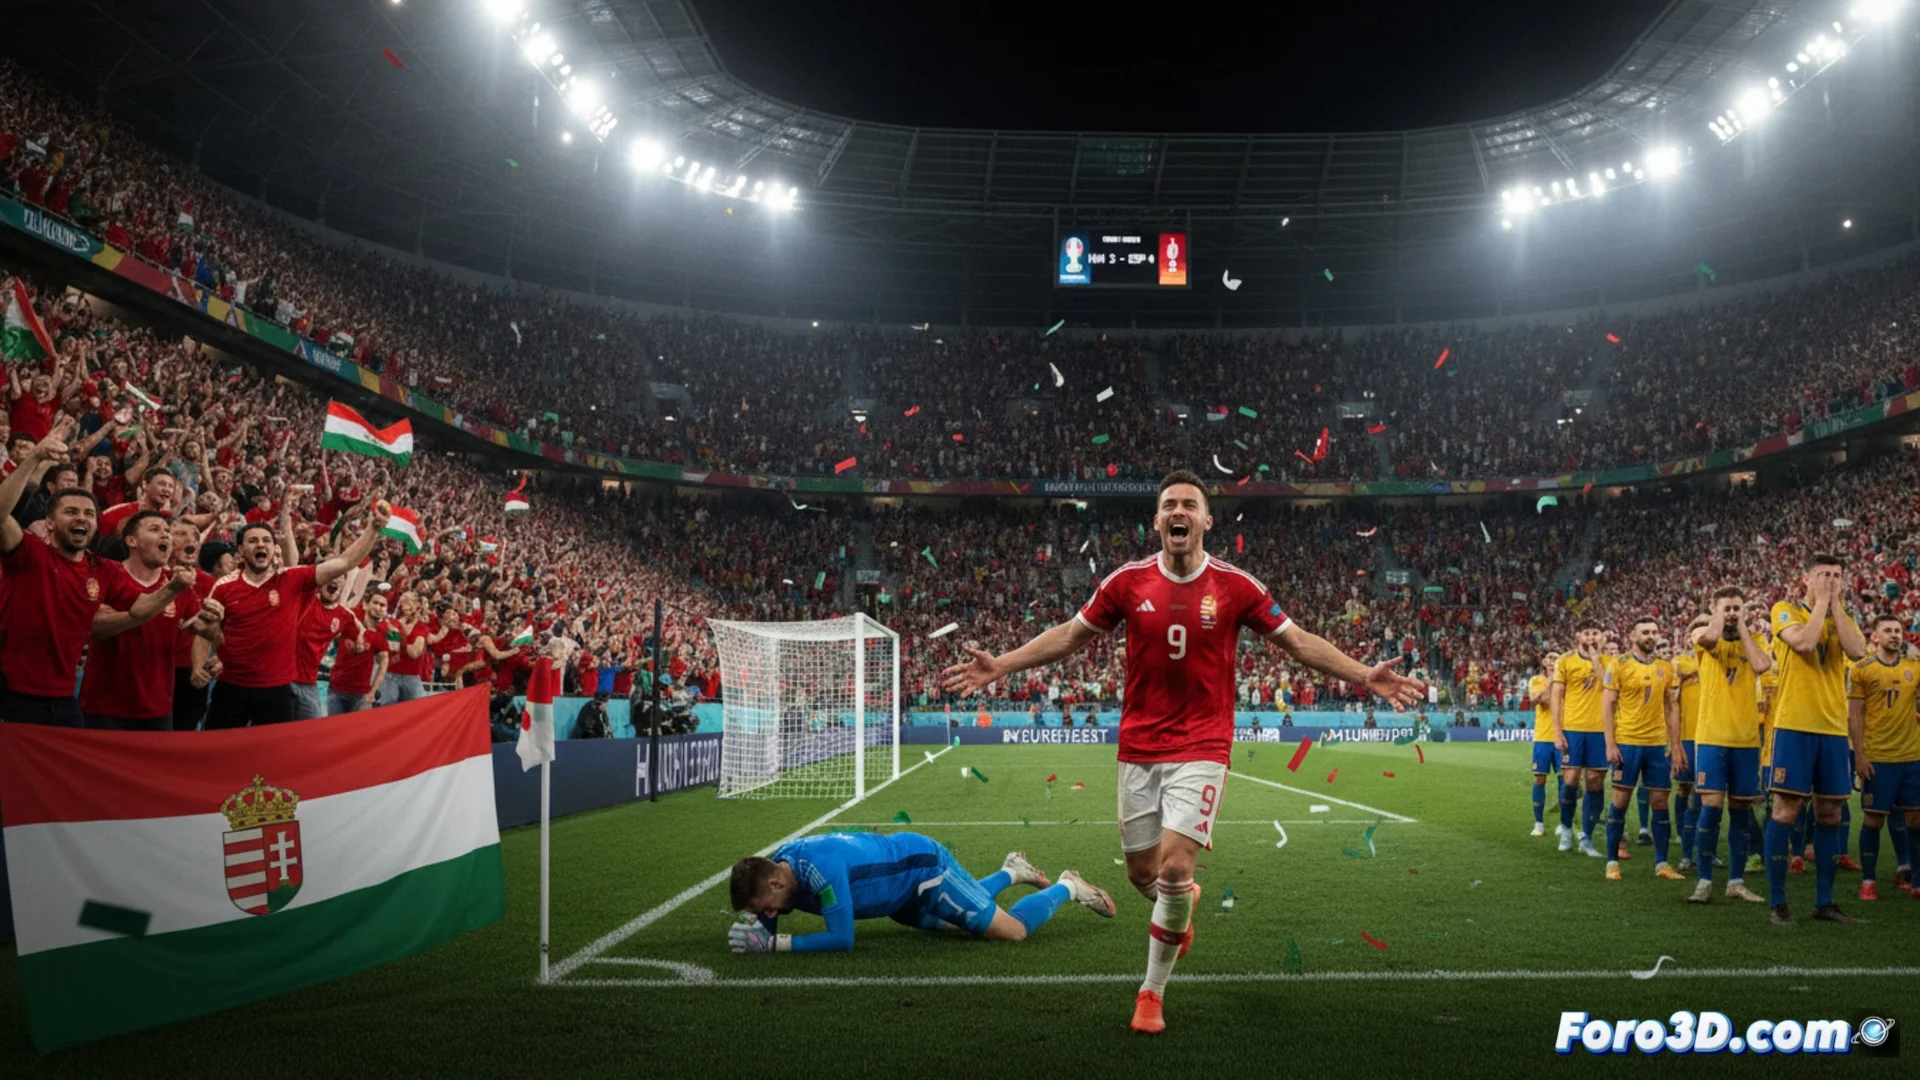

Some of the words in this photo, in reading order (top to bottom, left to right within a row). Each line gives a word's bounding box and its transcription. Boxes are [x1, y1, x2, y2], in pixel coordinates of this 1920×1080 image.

[1167, 624, 1186, 659] 9
[1200, 784, 1217, 817] 9
[938, 891, 964, 915] 7
